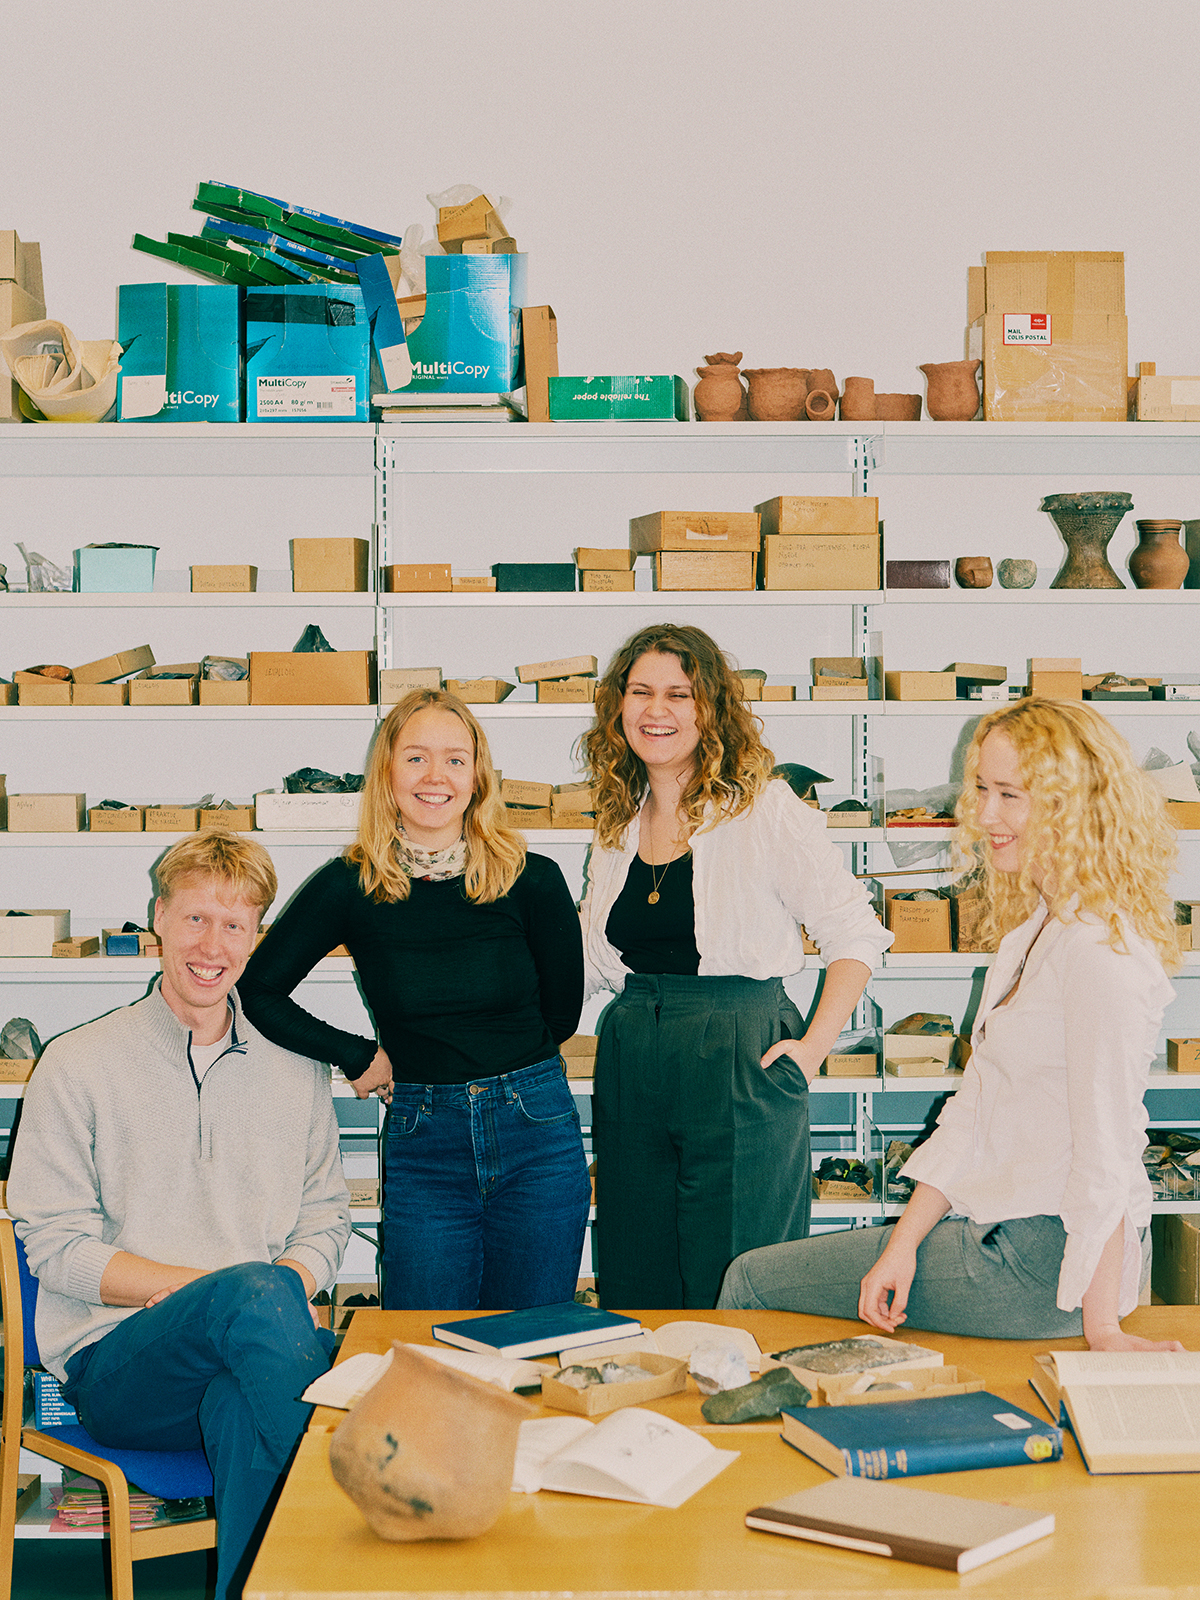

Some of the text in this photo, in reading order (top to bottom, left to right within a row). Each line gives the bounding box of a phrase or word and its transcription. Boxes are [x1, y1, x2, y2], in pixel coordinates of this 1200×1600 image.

[410, 361, 490, 379] MultiCopy
[258, 378, 307, 389] MultiCopy
[164, 390, 219, 408] ltiCopy
[572, 392, 650, 401] The reliable paper
